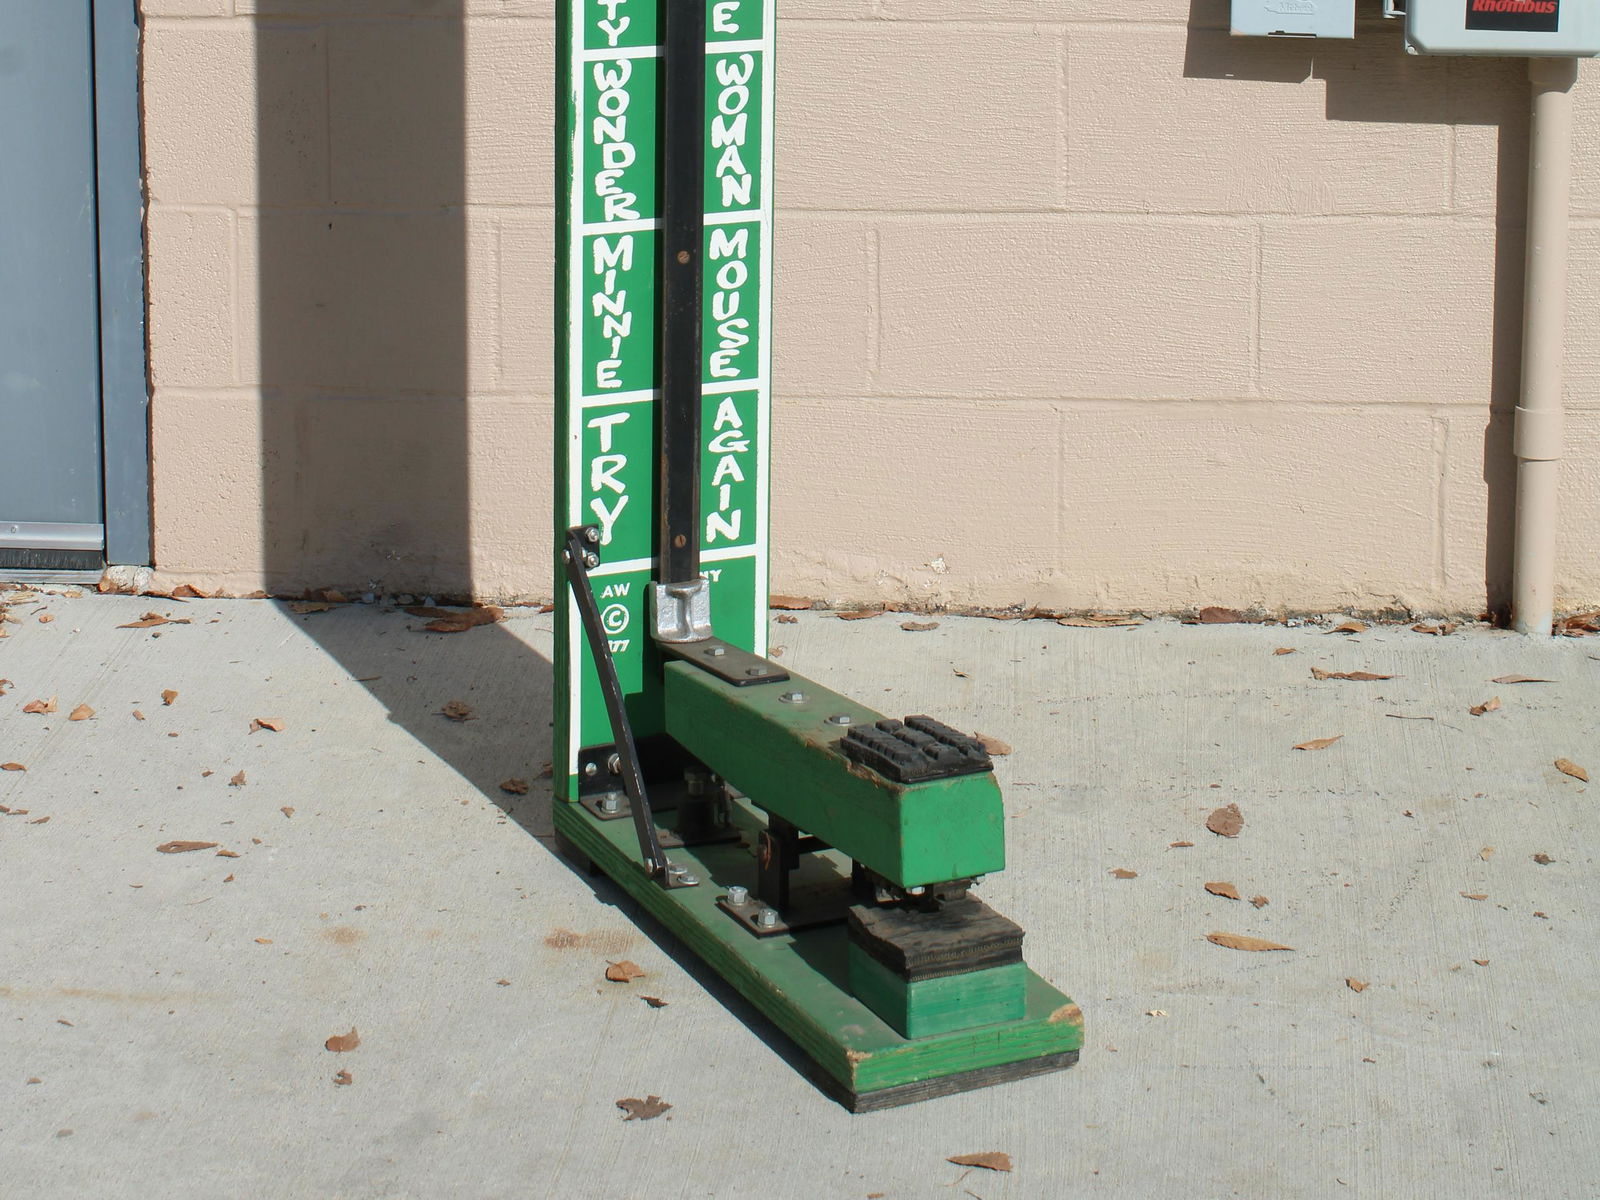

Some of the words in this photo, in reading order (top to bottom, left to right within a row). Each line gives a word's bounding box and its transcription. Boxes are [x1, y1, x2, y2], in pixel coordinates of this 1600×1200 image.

[592, 57, 641, 222] WONDER
[710, 53, 755, 208] WOMAN
[591, 234, 634, 389] MINNIE
[708, 227, 750, 378] MOUSE
[586, 411, 631, 546] TRY
[705, 396, 751, 543] AGAIN
[600, 582, 631, 599] AW
